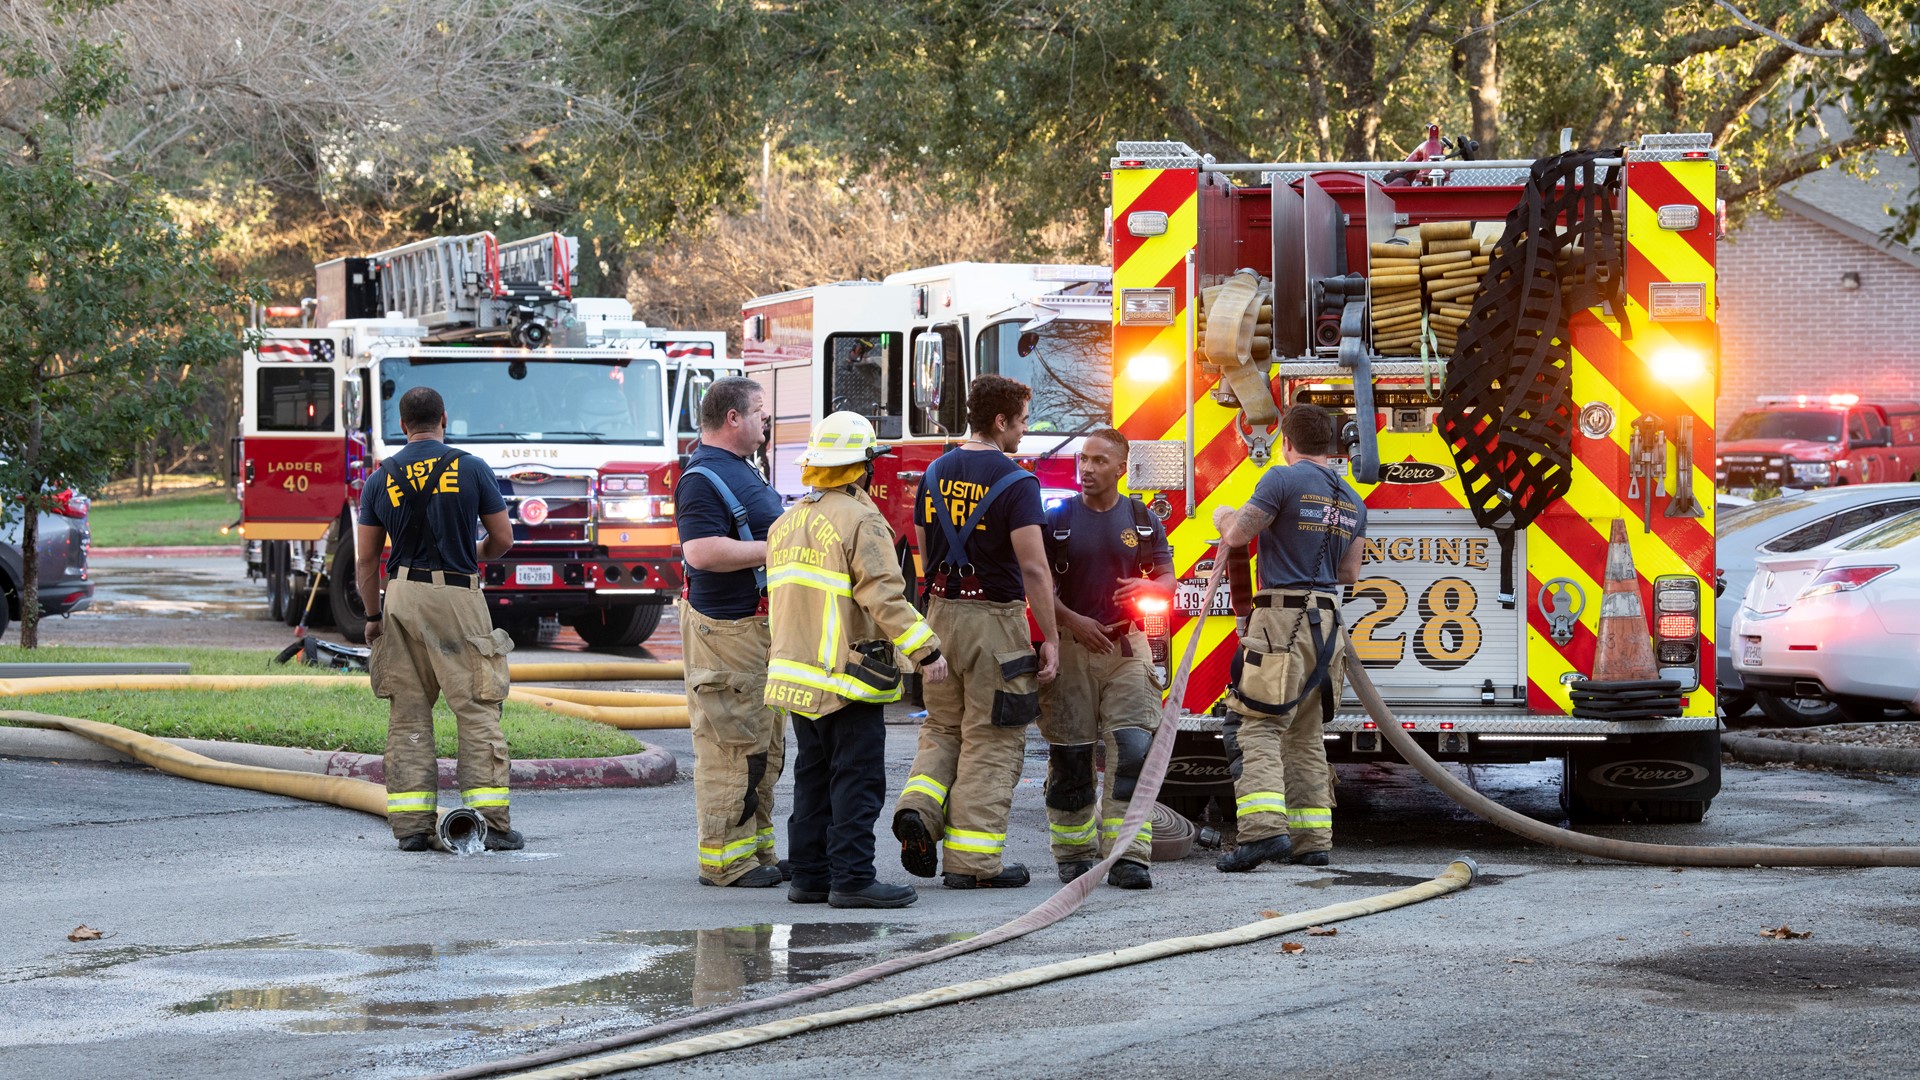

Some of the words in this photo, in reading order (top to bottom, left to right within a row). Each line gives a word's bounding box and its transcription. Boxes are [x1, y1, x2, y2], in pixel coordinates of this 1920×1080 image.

[502, 449, 558, 458] AUSTIN
[267, 462, 323, 474] LADDER
[1385, 462, 1435, 481] Pierce
[282, 475, 309, 493] 40
[387, 471, 460, 508] FE
[926, 478, 990, 501] USTIN
[771, 508, 811, 552] AUSTIN
[810, 513, 841, 553] FIRE
[1361, 537, 1489, 571] NGINE
[1342, 576, 1483, 671] 28
[1164, 762, 1232, 778] Pierce
[1610, 766, 1688, 781] Pierce
